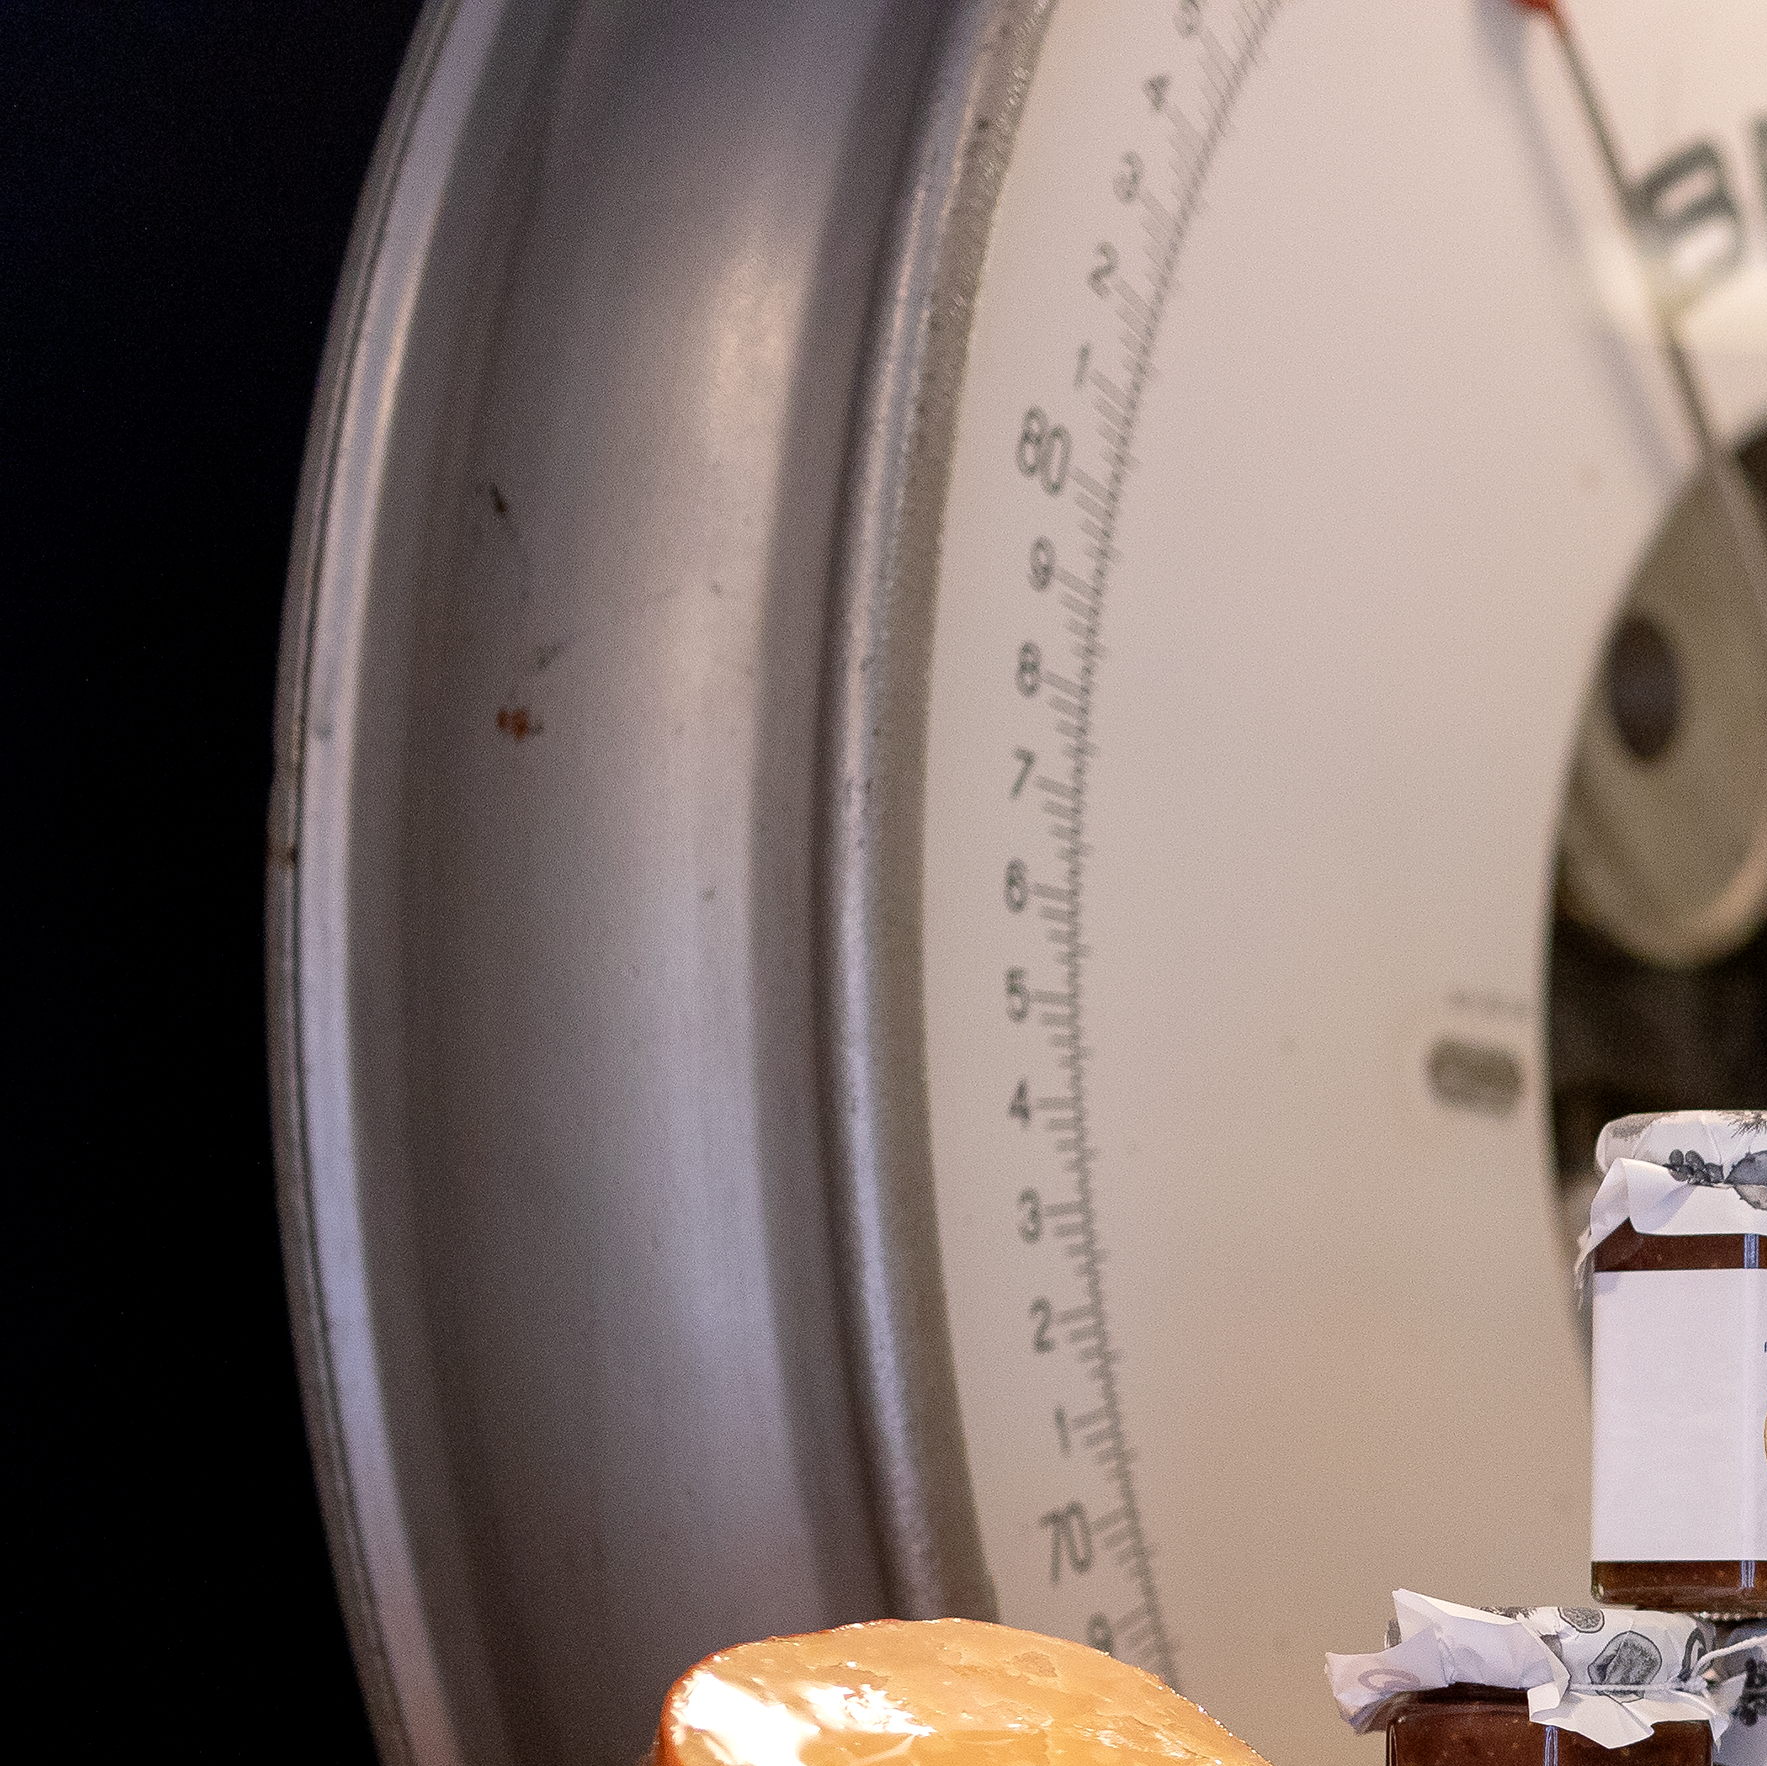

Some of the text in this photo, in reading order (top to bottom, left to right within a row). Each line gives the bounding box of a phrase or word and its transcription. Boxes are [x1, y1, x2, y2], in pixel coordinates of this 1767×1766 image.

[1086, 241, 1119, 298] 2
[1015, 404, 1071, 496] 80
[1015, 640, 1042, 697] 8
[1011, 746, 1036, 799] 7
[1004, 966, 1029, 1023] 5
[1007, 1076, 1031, 1130] 4
[1017, 1186, 1041, 1244] 3
[1029, 1297, 1054, 1354] 2
[1038, 1500, 1094, 1584] 70
